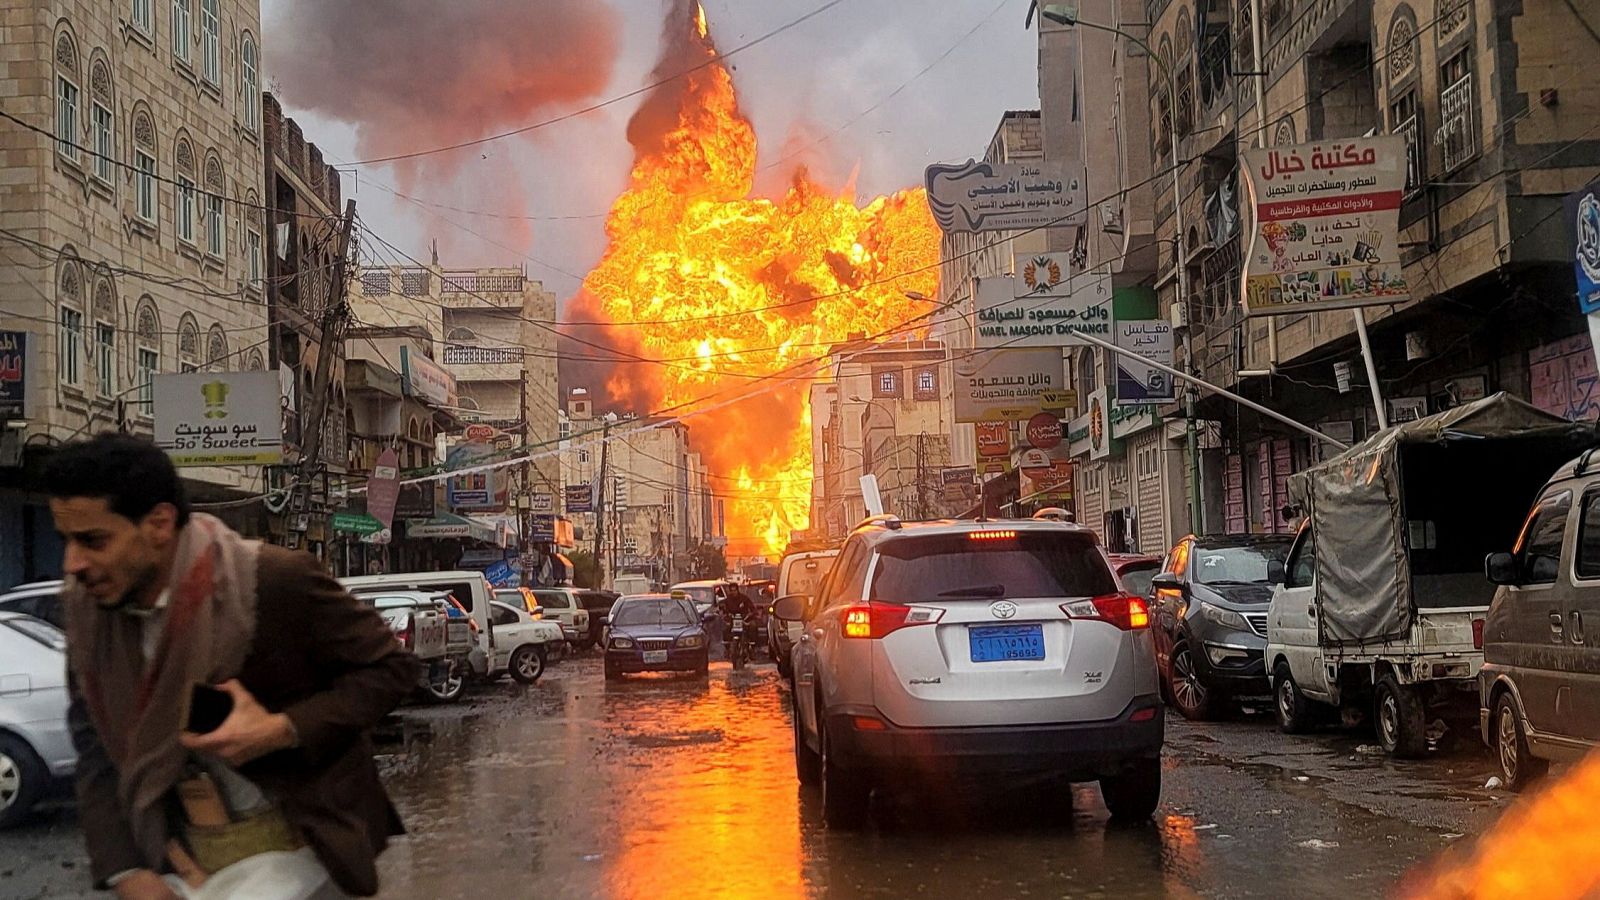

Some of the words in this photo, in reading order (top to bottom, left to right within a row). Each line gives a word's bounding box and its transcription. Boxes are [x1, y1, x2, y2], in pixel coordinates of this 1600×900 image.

[1261, 148, 1305, 180] خيال
[1311, 144, 1376, 175] مكتبة
[1020, 166, 1040, 177] عيادة
[967, 177, 1020, 202] الأصبحي
[1024, 179, 1062, 196] وهيب
[1297, 180, 1346, 195] ومستحضرات
[1348, 176, 1376, 190] للعطور
[1266, 184, 1295, 198] التجميل
[978, 306, 1024, 322] للصرافة
[1028, 308, 1076, 321] مسعود
[1080, 304, 1108, 320] وائل
[979, 326, 1007, 337] WAEL
[1009, 324, 1053, 336] MASOUD
[1056, 323, 1109, 334] EXCHANGE
[970, 375, 1025, 387] مسعود
[1028, 373, 1051, 386] وائل
[175, 424, 228, 440] سويت
[232, 424, 257, 439] سو
[174, 437, 196, 449] So
[202, 437, 258, 449] Sweet
